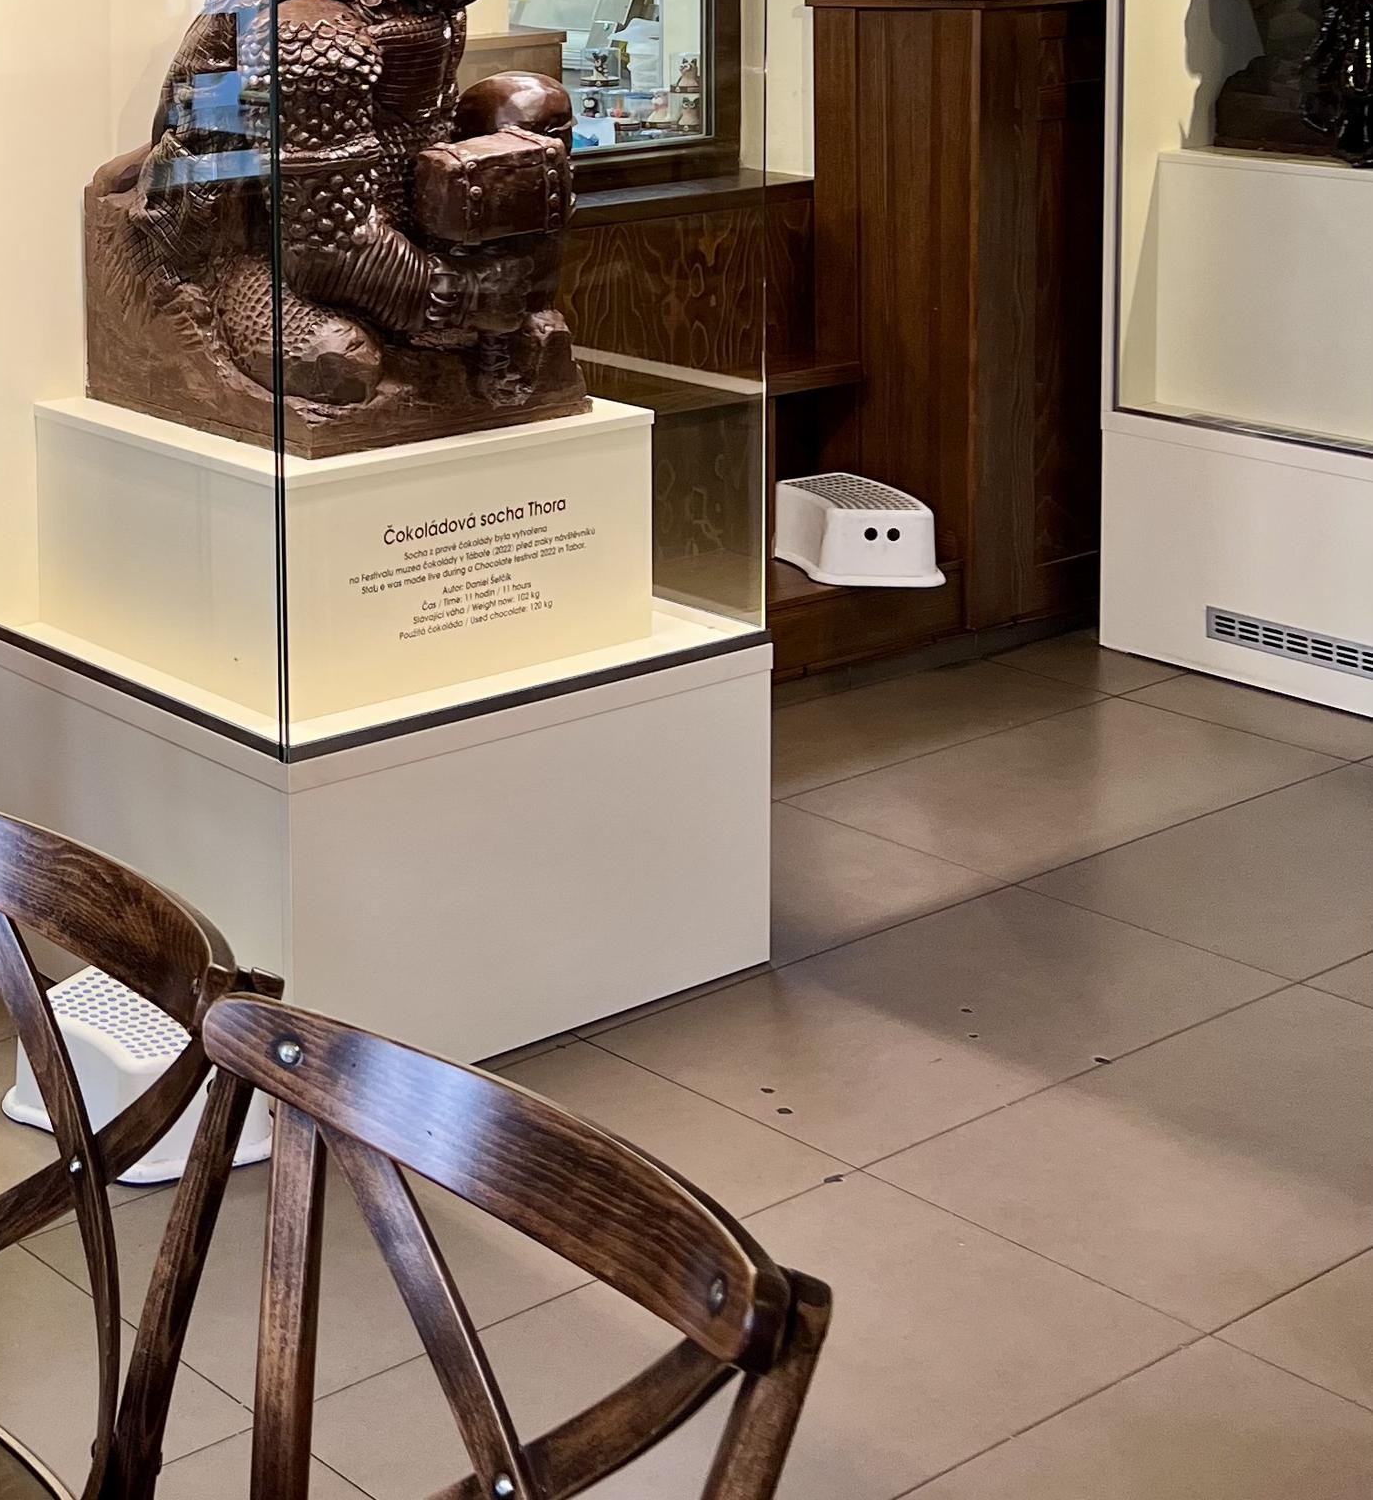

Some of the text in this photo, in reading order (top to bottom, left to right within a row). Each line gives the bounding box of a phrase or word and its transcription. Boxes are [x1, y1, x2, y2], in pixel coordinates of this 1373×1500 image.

[383, 499, 567, 546] Čokoládová socha Thora
[404, 549, 428, 561] Socha
[361, 569, 394, 582] Festivalu
[395, 564, 421, 575] muzea
[423, 556, 458, 570] čokolády
[387, 580, 402, 589] was
[403, 575, 426, 586] made
[442, 566, 466, 579] during
[474, 557, 513, 572] Chocolate
[531, 590, 541, 601] kg
